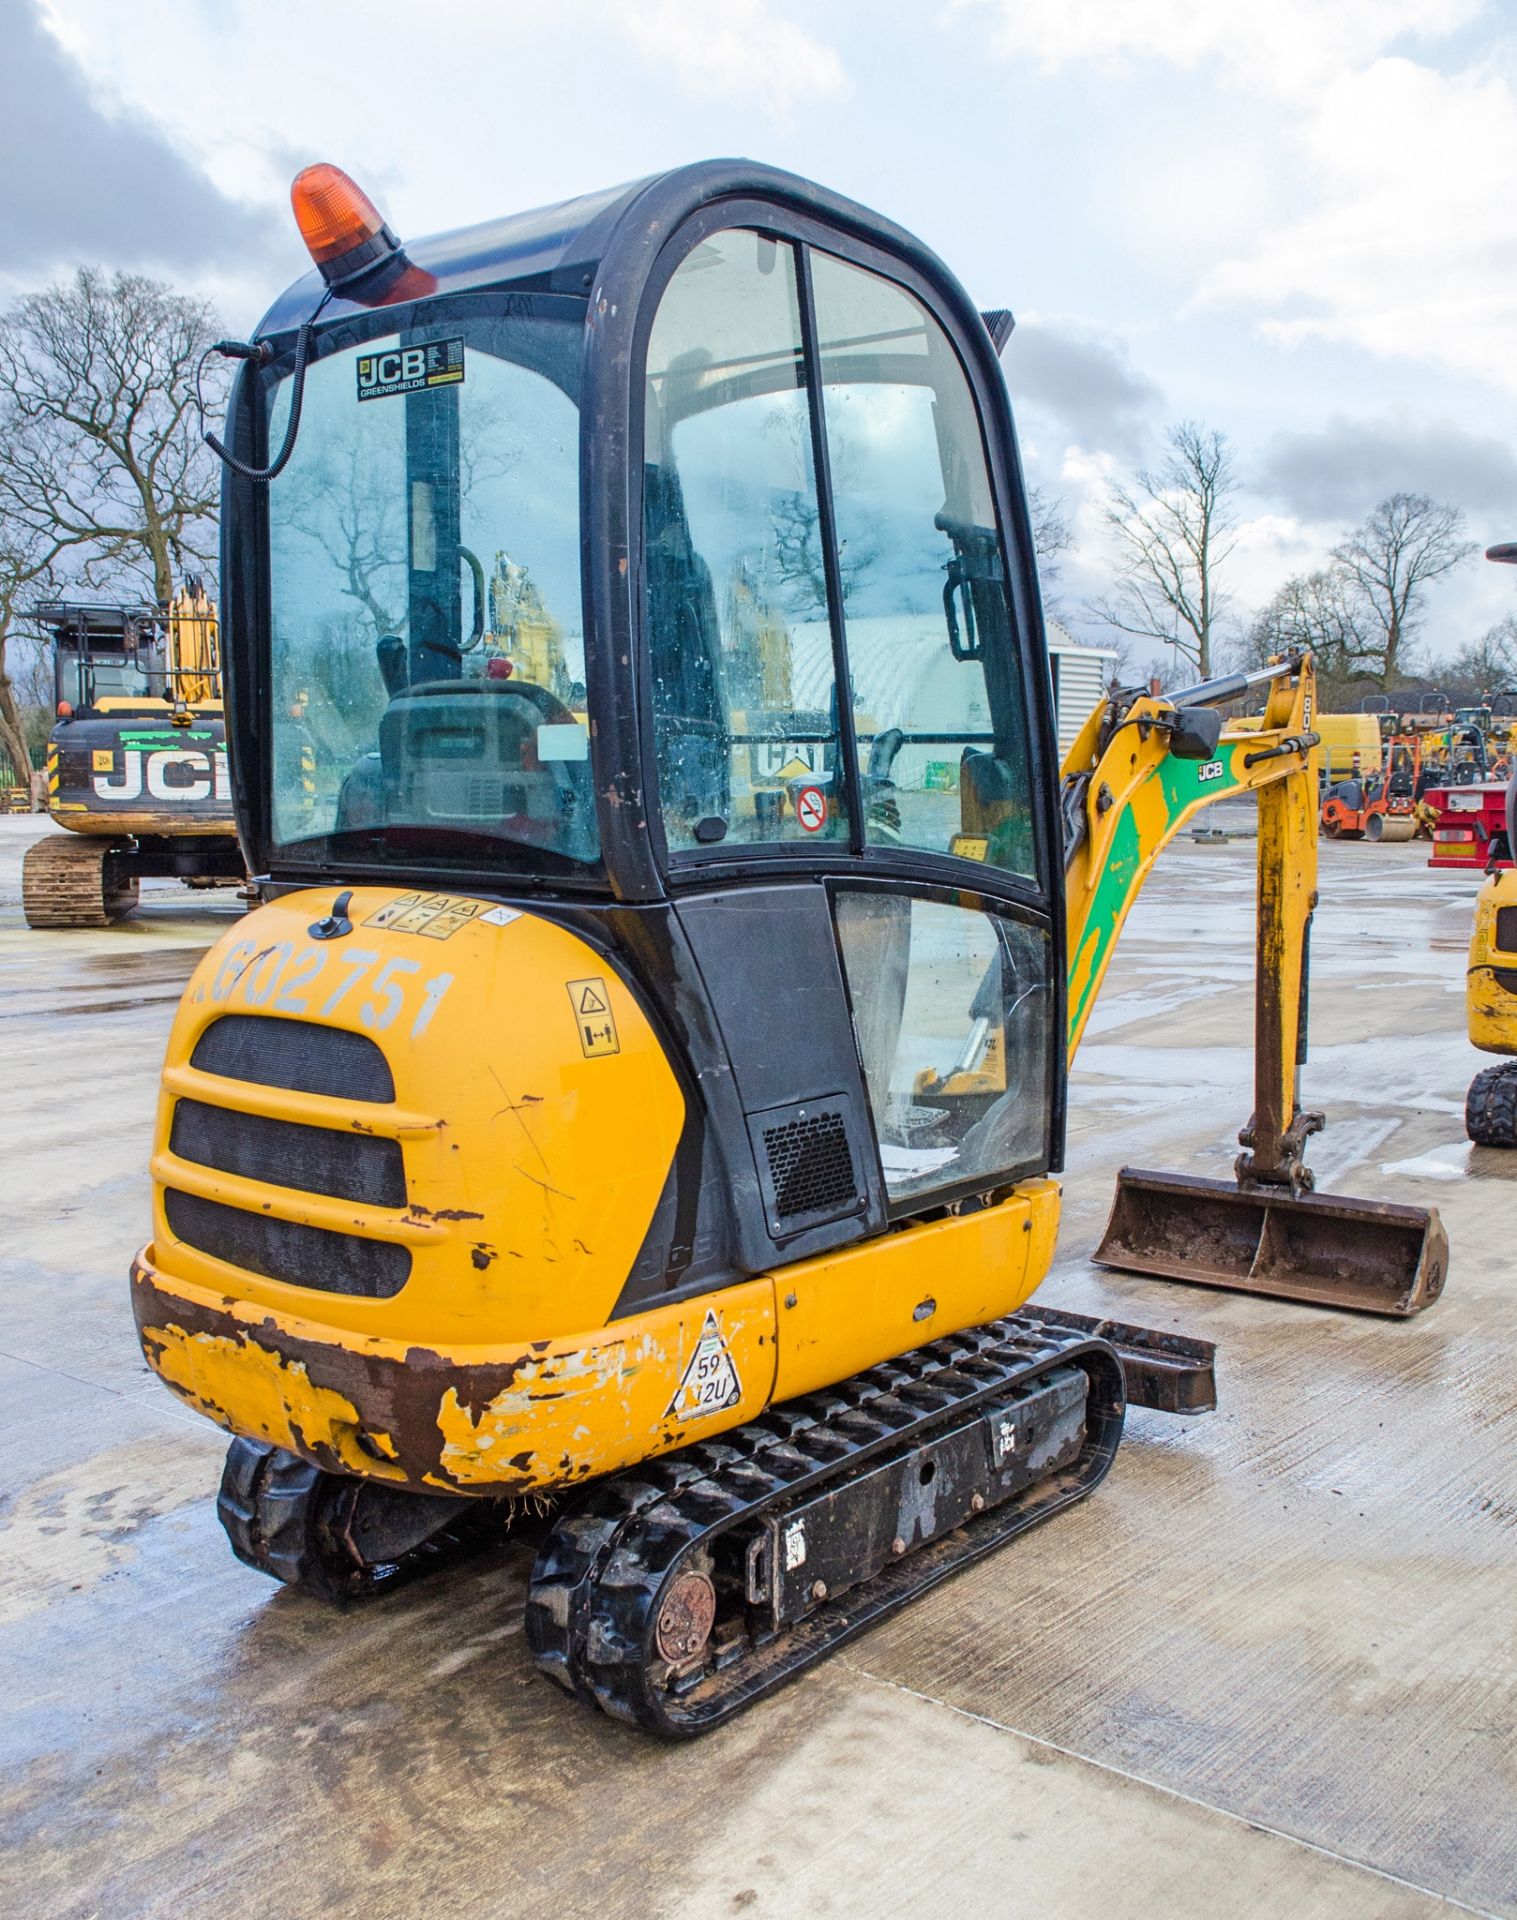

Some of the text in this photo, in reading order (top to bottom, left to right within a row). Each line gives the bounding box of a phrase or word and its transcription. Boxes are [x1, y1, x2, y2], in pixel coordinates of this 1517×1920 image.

[359, 349, 426, 388] JCB
[360, 378, 426, 398] GREENSHIELDS
[1199, 761, 1223, 781] JCB
[196, 940, 455, 1040] 602751
[697, 1354, 720, 1380] 59
